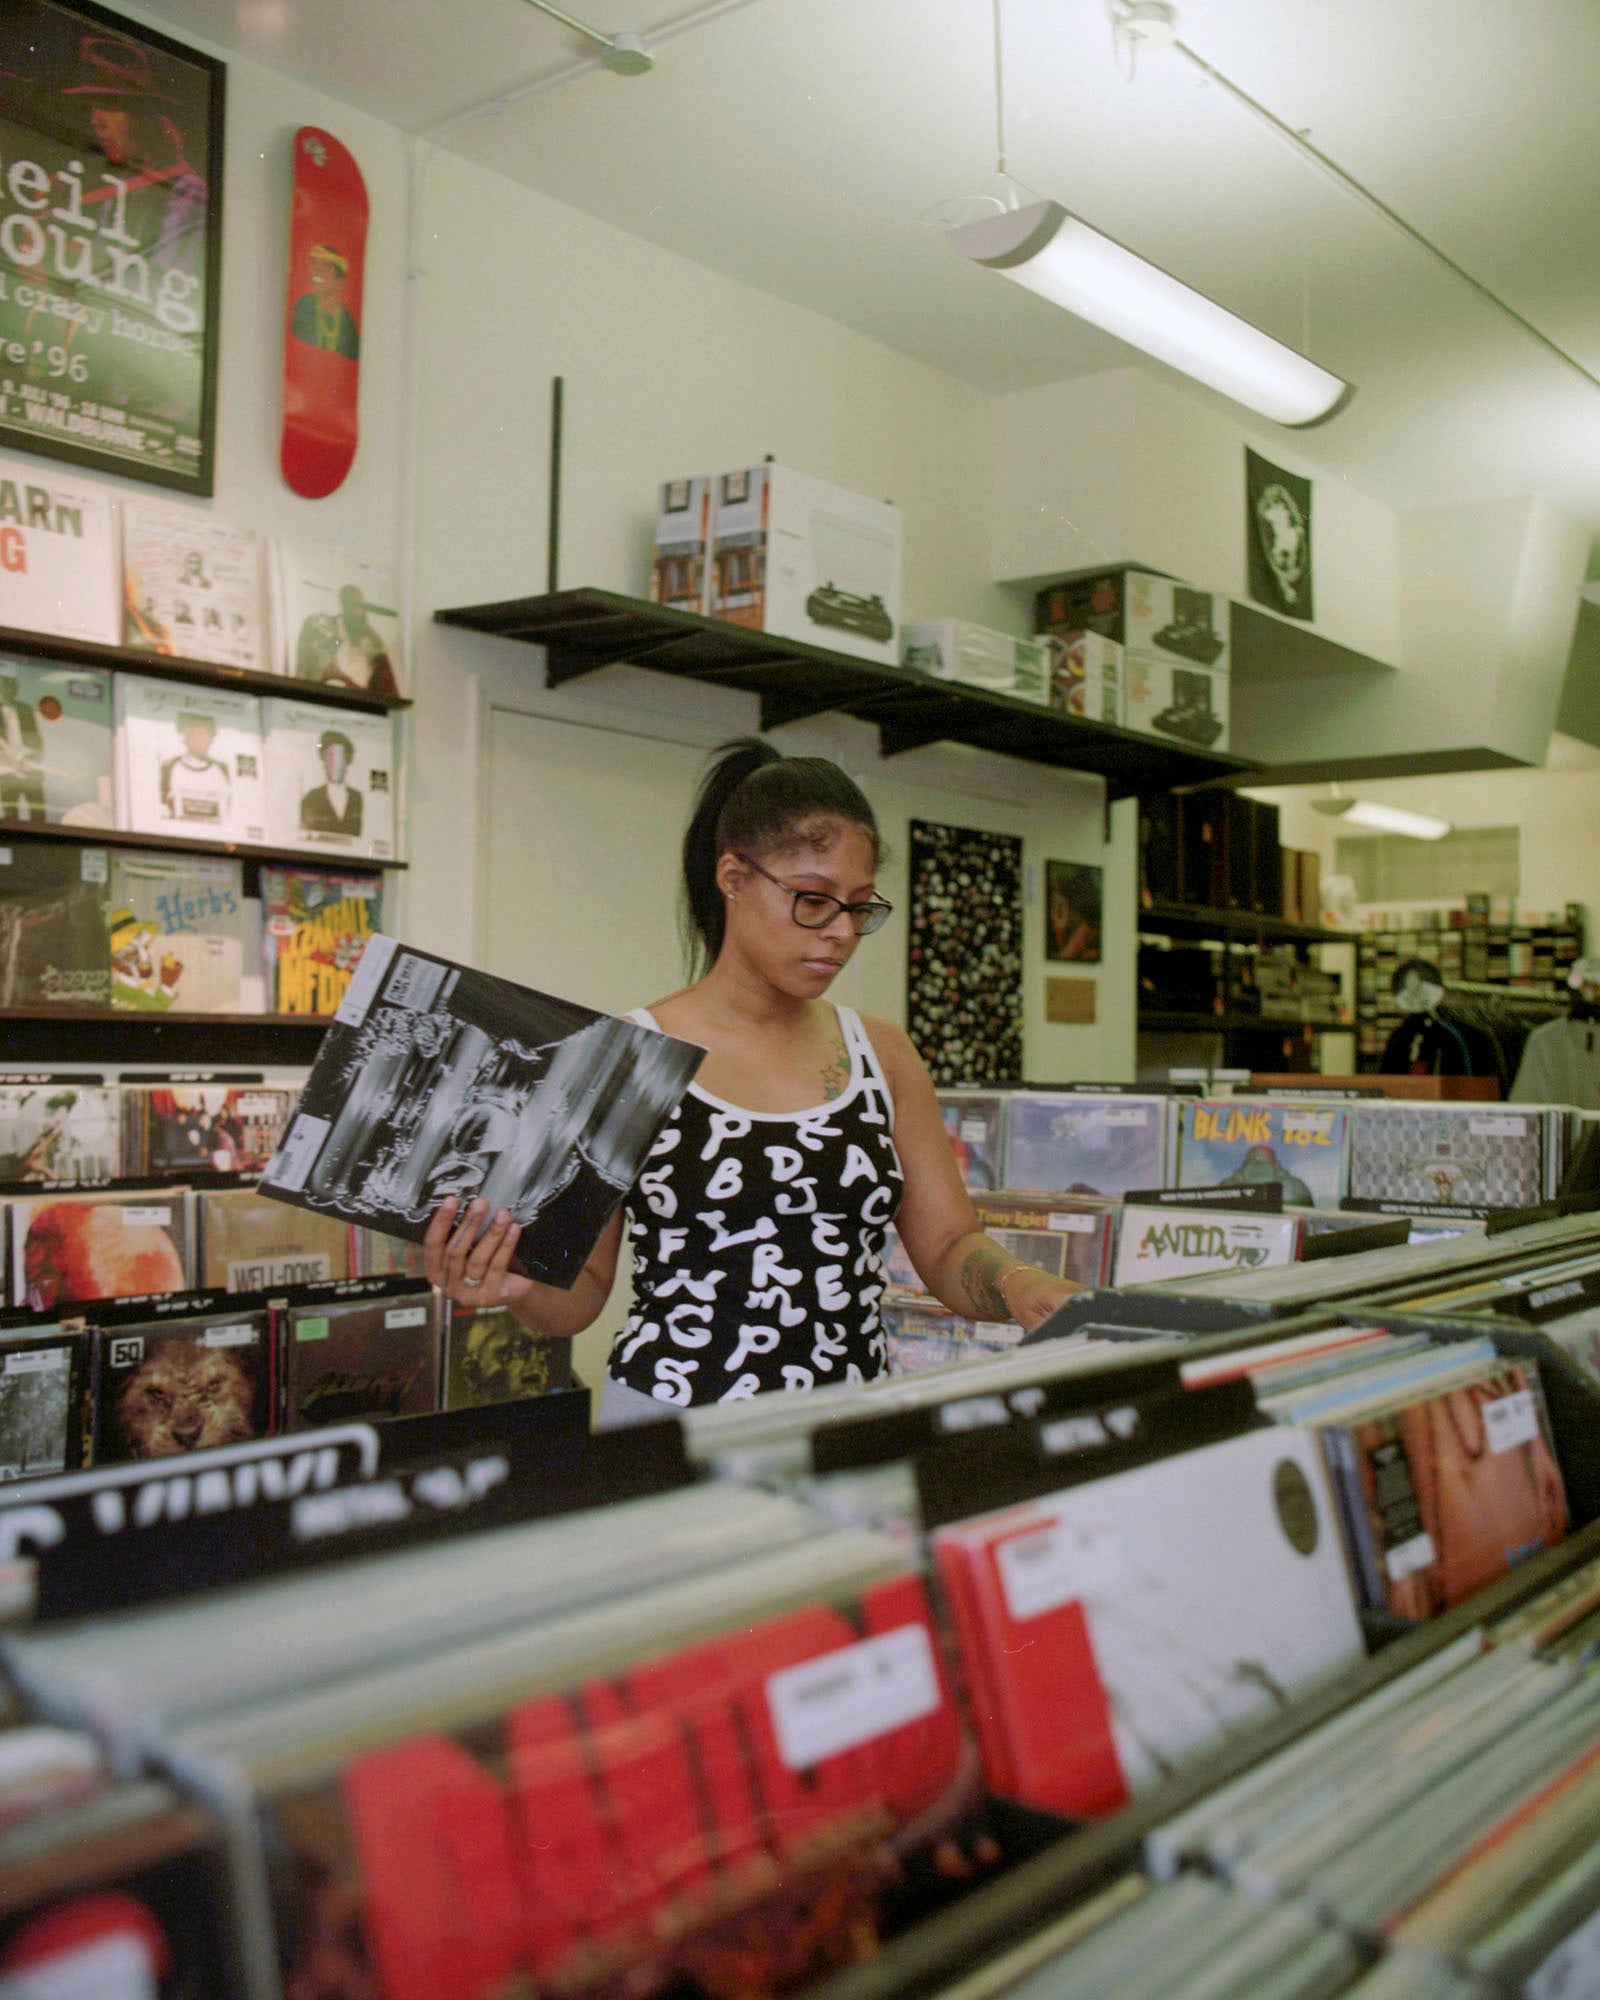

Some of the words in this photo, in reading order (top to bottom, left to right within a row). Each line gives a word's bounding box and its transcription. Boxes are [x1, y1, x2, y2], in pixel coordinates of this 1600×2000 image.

[0, 158, 140, 247] eil
[13, 285, 105, 335] crazy
[111, 308, 199, 358] horse
[154, 886, 238, 933] Herbs
[1193, 1107, 1273, 1144] BLINK
[705, 1157, 743, 1200] B
[839, 1144, 878, 1188] A
[752, 1243, 803, 1289] R
[815, 1264, 851, 1312] E
[115, 1342, 140, 1363] 50
